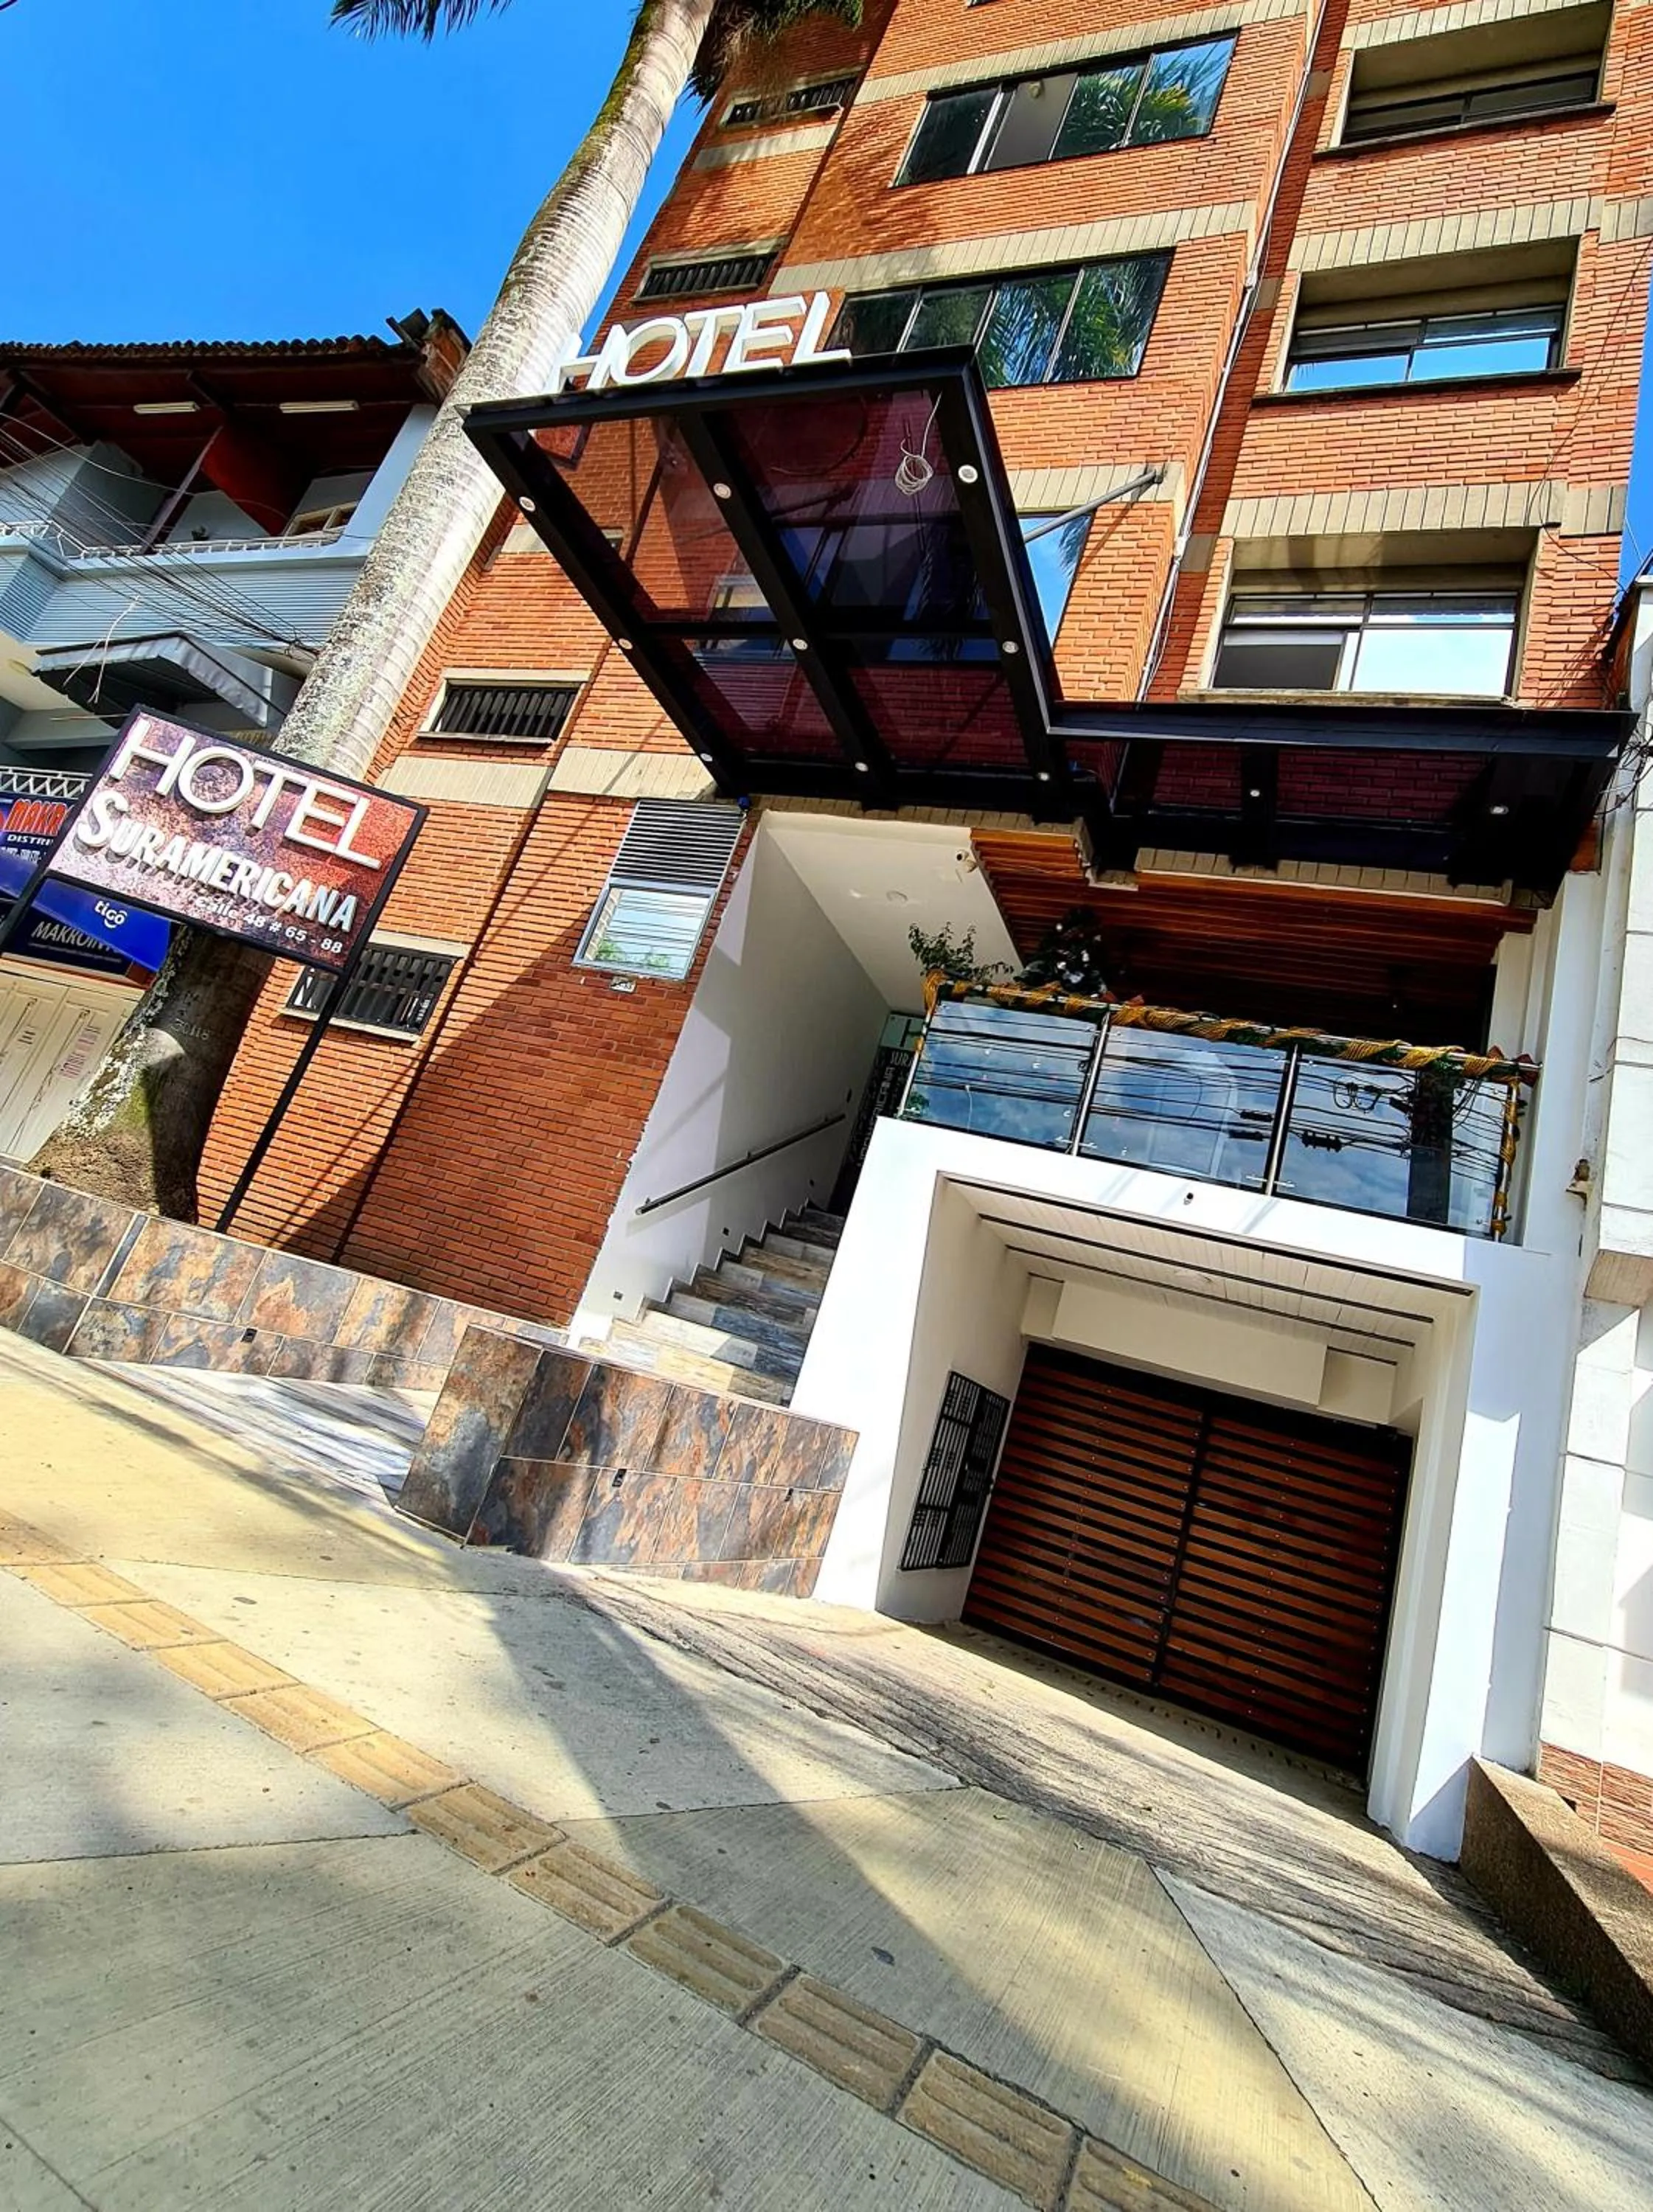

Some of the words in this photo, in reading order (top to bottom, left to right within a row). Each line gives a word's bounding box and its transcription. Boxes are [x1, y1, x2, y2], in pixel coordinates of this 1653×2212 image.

[543, 289, 852, 396] HOTEL
[1, 798, 74, 837] MAKR
[108, 717, 382, 870] HOTEL
[7, 833, 54, 846] DISTRI
[75, 789, 358, 933] SURAMERICANA
[195, 894, 239, 920] Calle
[243, 913, 266, 928] 48
[268, 921, 282, 933] #
[285, 925, 307, 942] 65
[320, 937, 343, 954] 88
